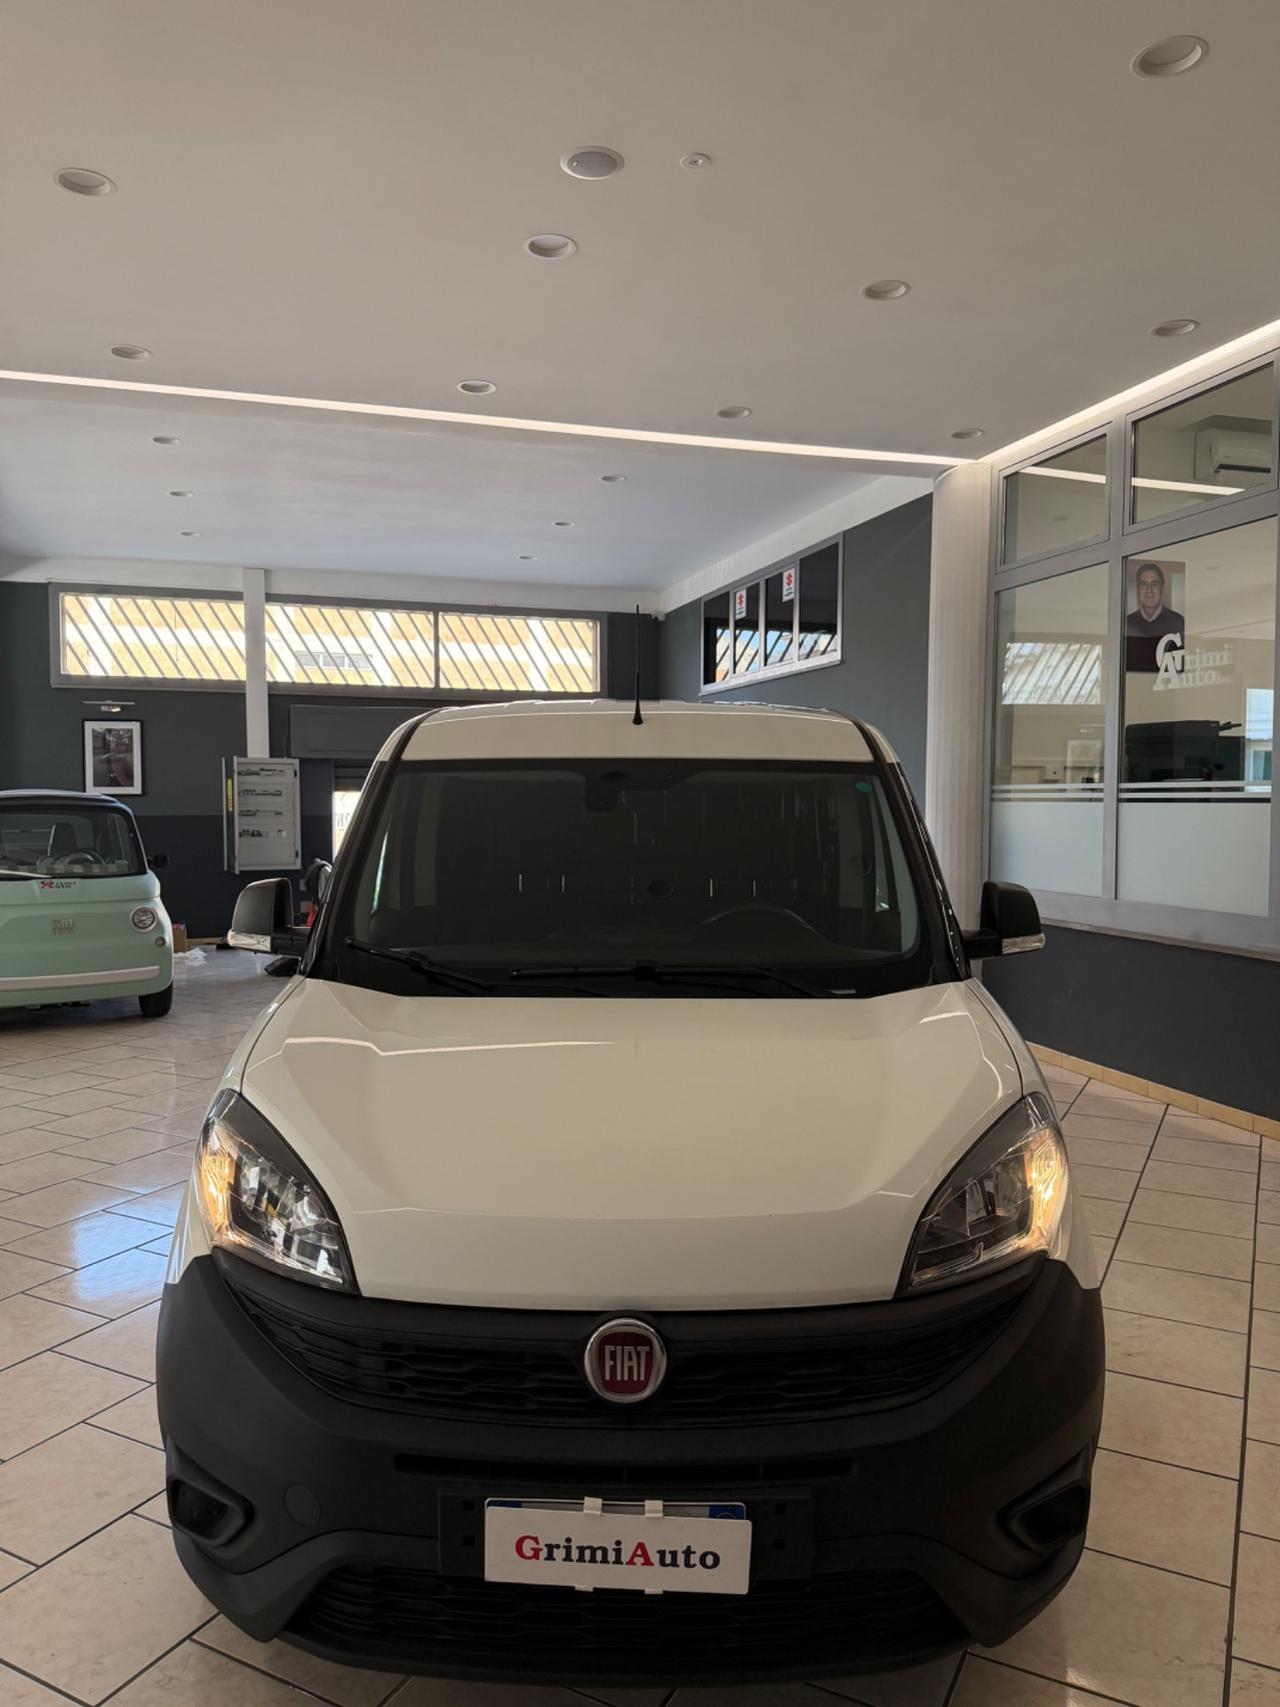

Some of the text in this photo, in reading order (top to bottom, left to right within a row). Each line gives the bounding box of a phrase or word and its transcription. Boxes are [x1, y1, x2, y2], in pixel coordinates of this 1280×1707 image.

[1152, 651, 1217, 691] Auto
[604, 1345, 650, 1381] FIAT
[515, 1535, 721, 1570] GrimiAuto
